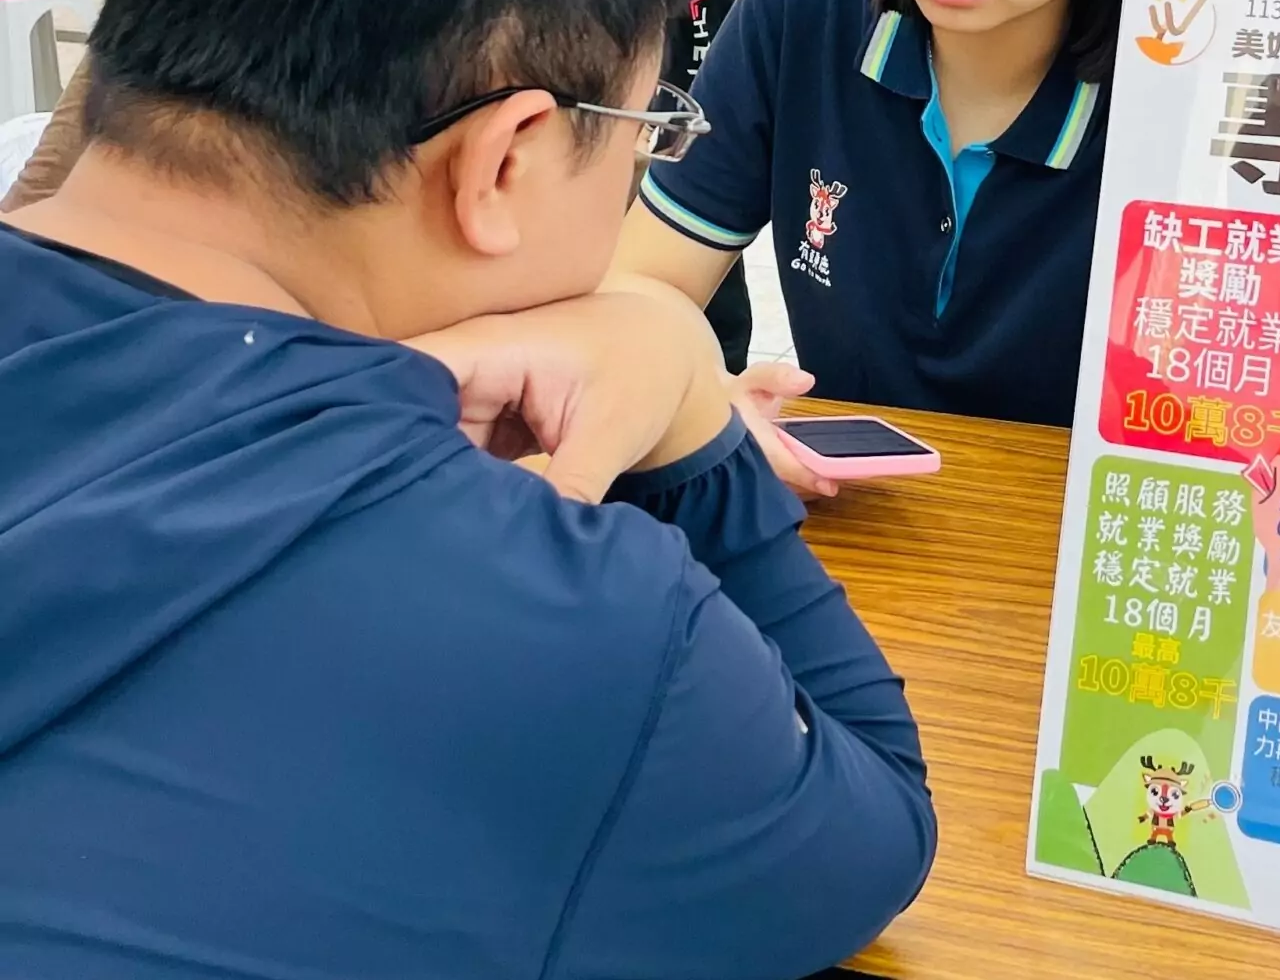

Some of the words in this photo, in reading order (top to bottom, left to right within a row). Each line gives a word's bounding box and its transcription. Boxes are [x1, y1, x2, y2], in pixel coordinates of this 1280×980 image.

[1177, 258, 1262, 307] 獎勵
[1146, 345, 1272, 397] 18個月
[1101, 471, 1247, 527] 照顧服務
[1096, 510, 1241, 566] 就業獎勵
[1093, 549, 1237, 606] 穩定就業
[1103, 594, 1213, 642] 18個月
[1131, 631, 1183, 665] 最高
